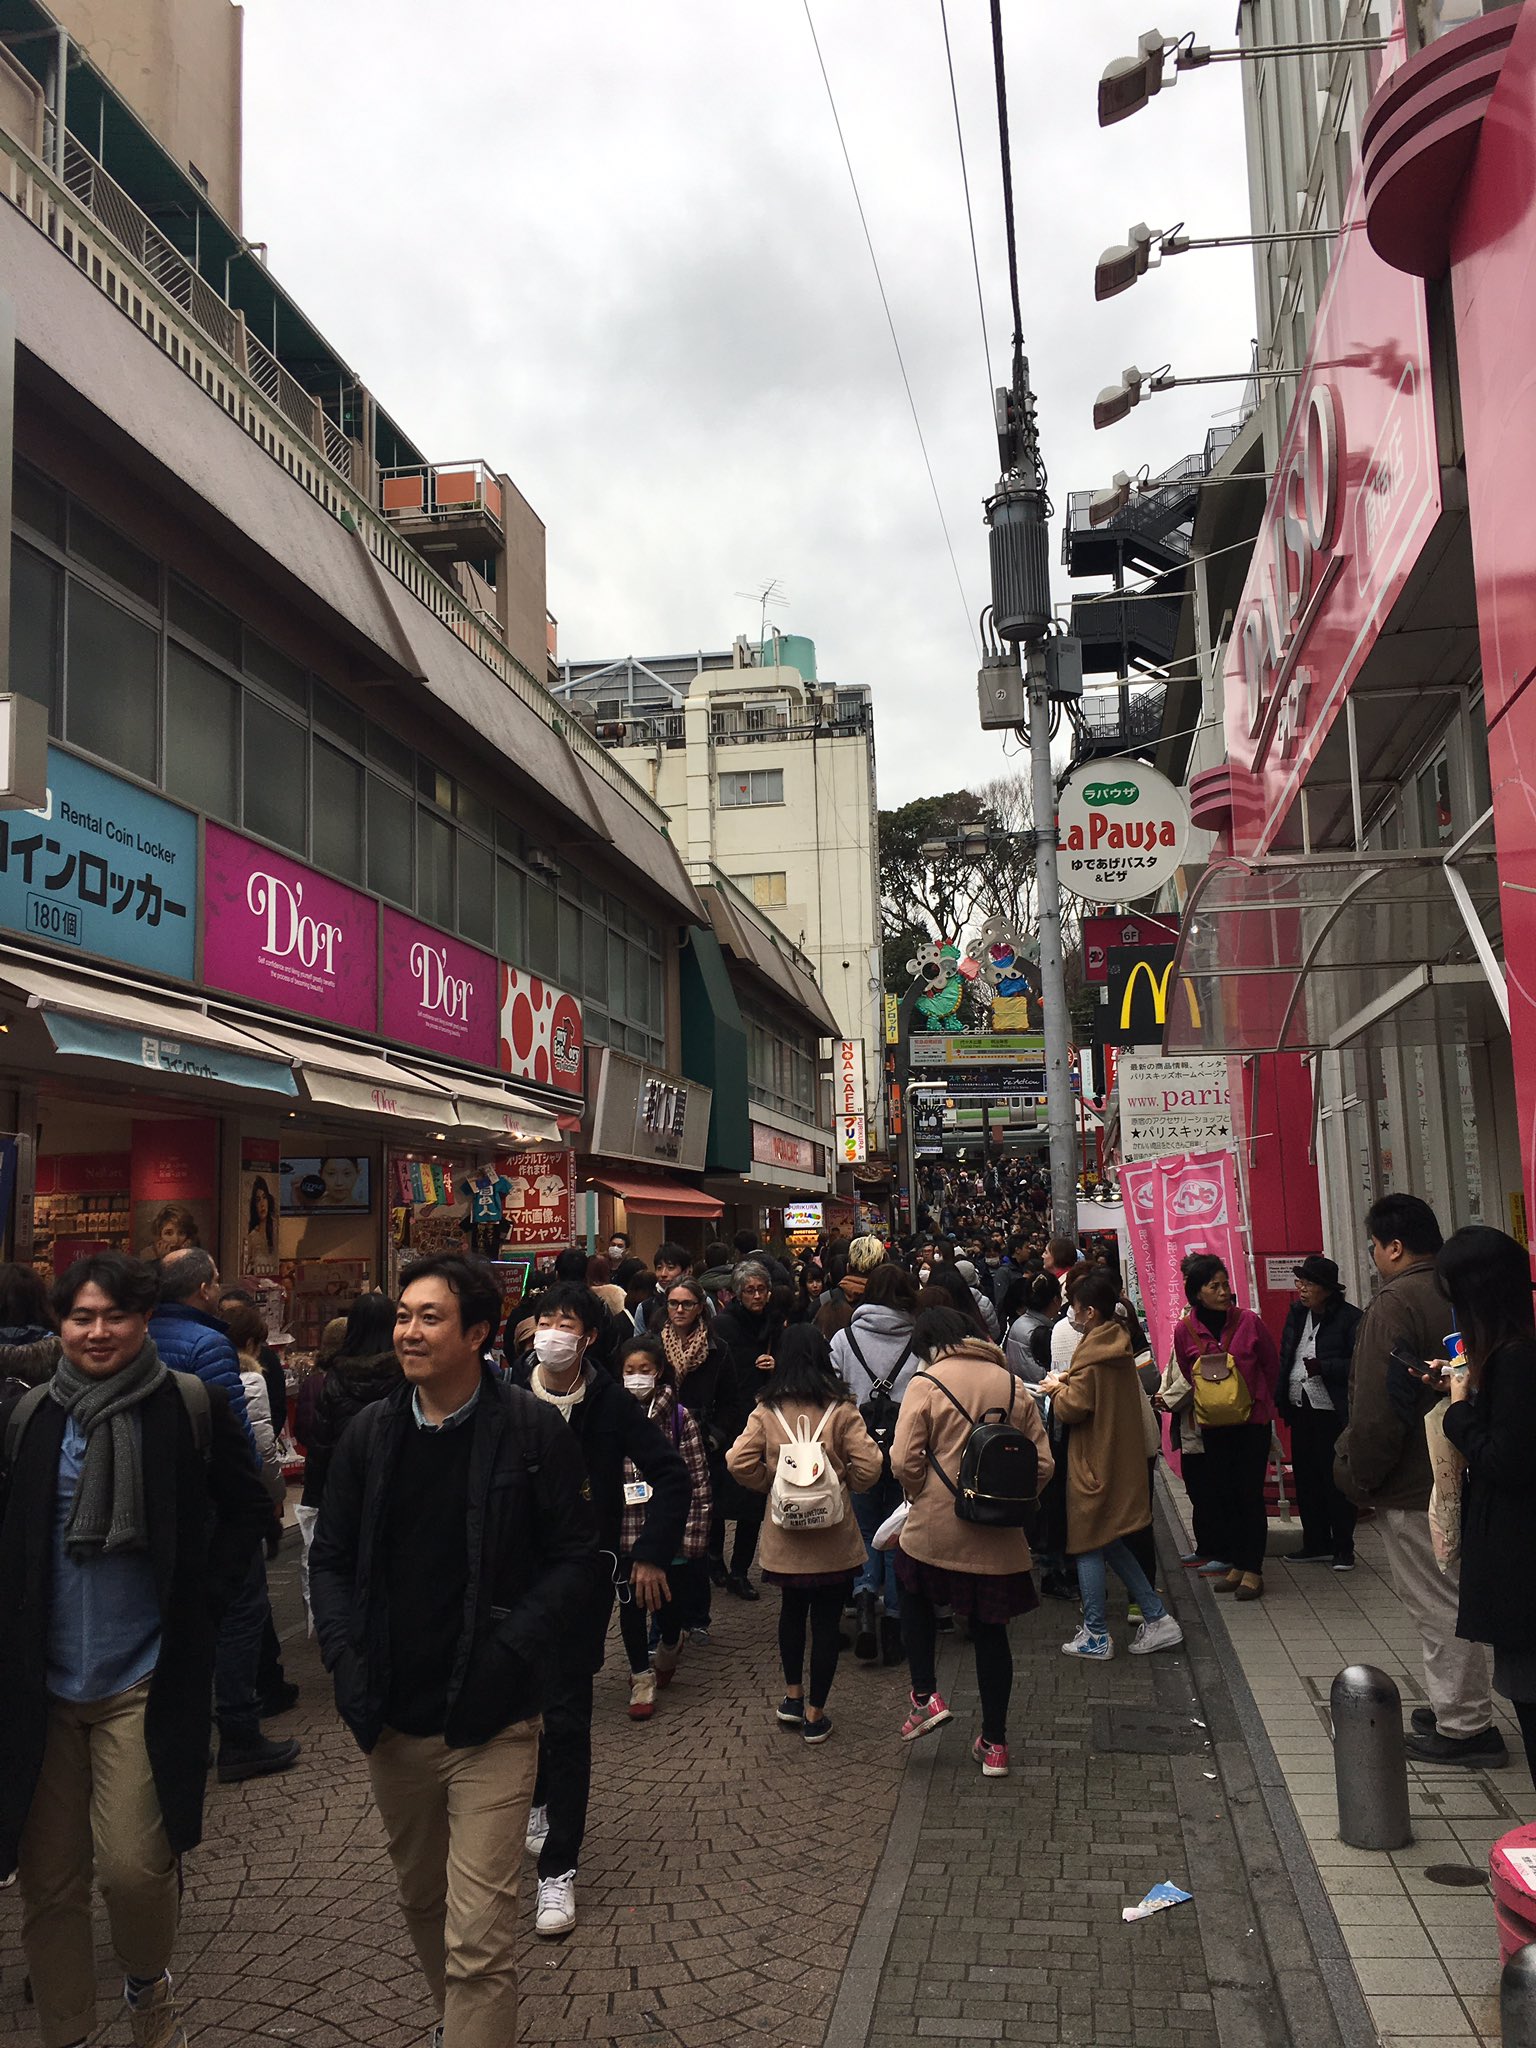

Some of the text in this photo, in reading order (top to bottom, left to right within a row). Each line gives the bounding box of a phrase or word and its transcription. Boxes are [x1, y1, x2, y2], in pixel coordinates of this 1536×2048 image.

[60, 801, 177, 865] Rental Coin Locker
[1089, 812, 1176, 852] Pausa
[33, 901, 78, 938] 180個
[247, 871, 343, 975] D'or
[1124, 931, 1137, 940] 6F
[410, 942, 473, 1022] D'or
[842, 1042, 855, 1113] NOA CAFE
[844, 1117, 857, 1161] プリクラ
